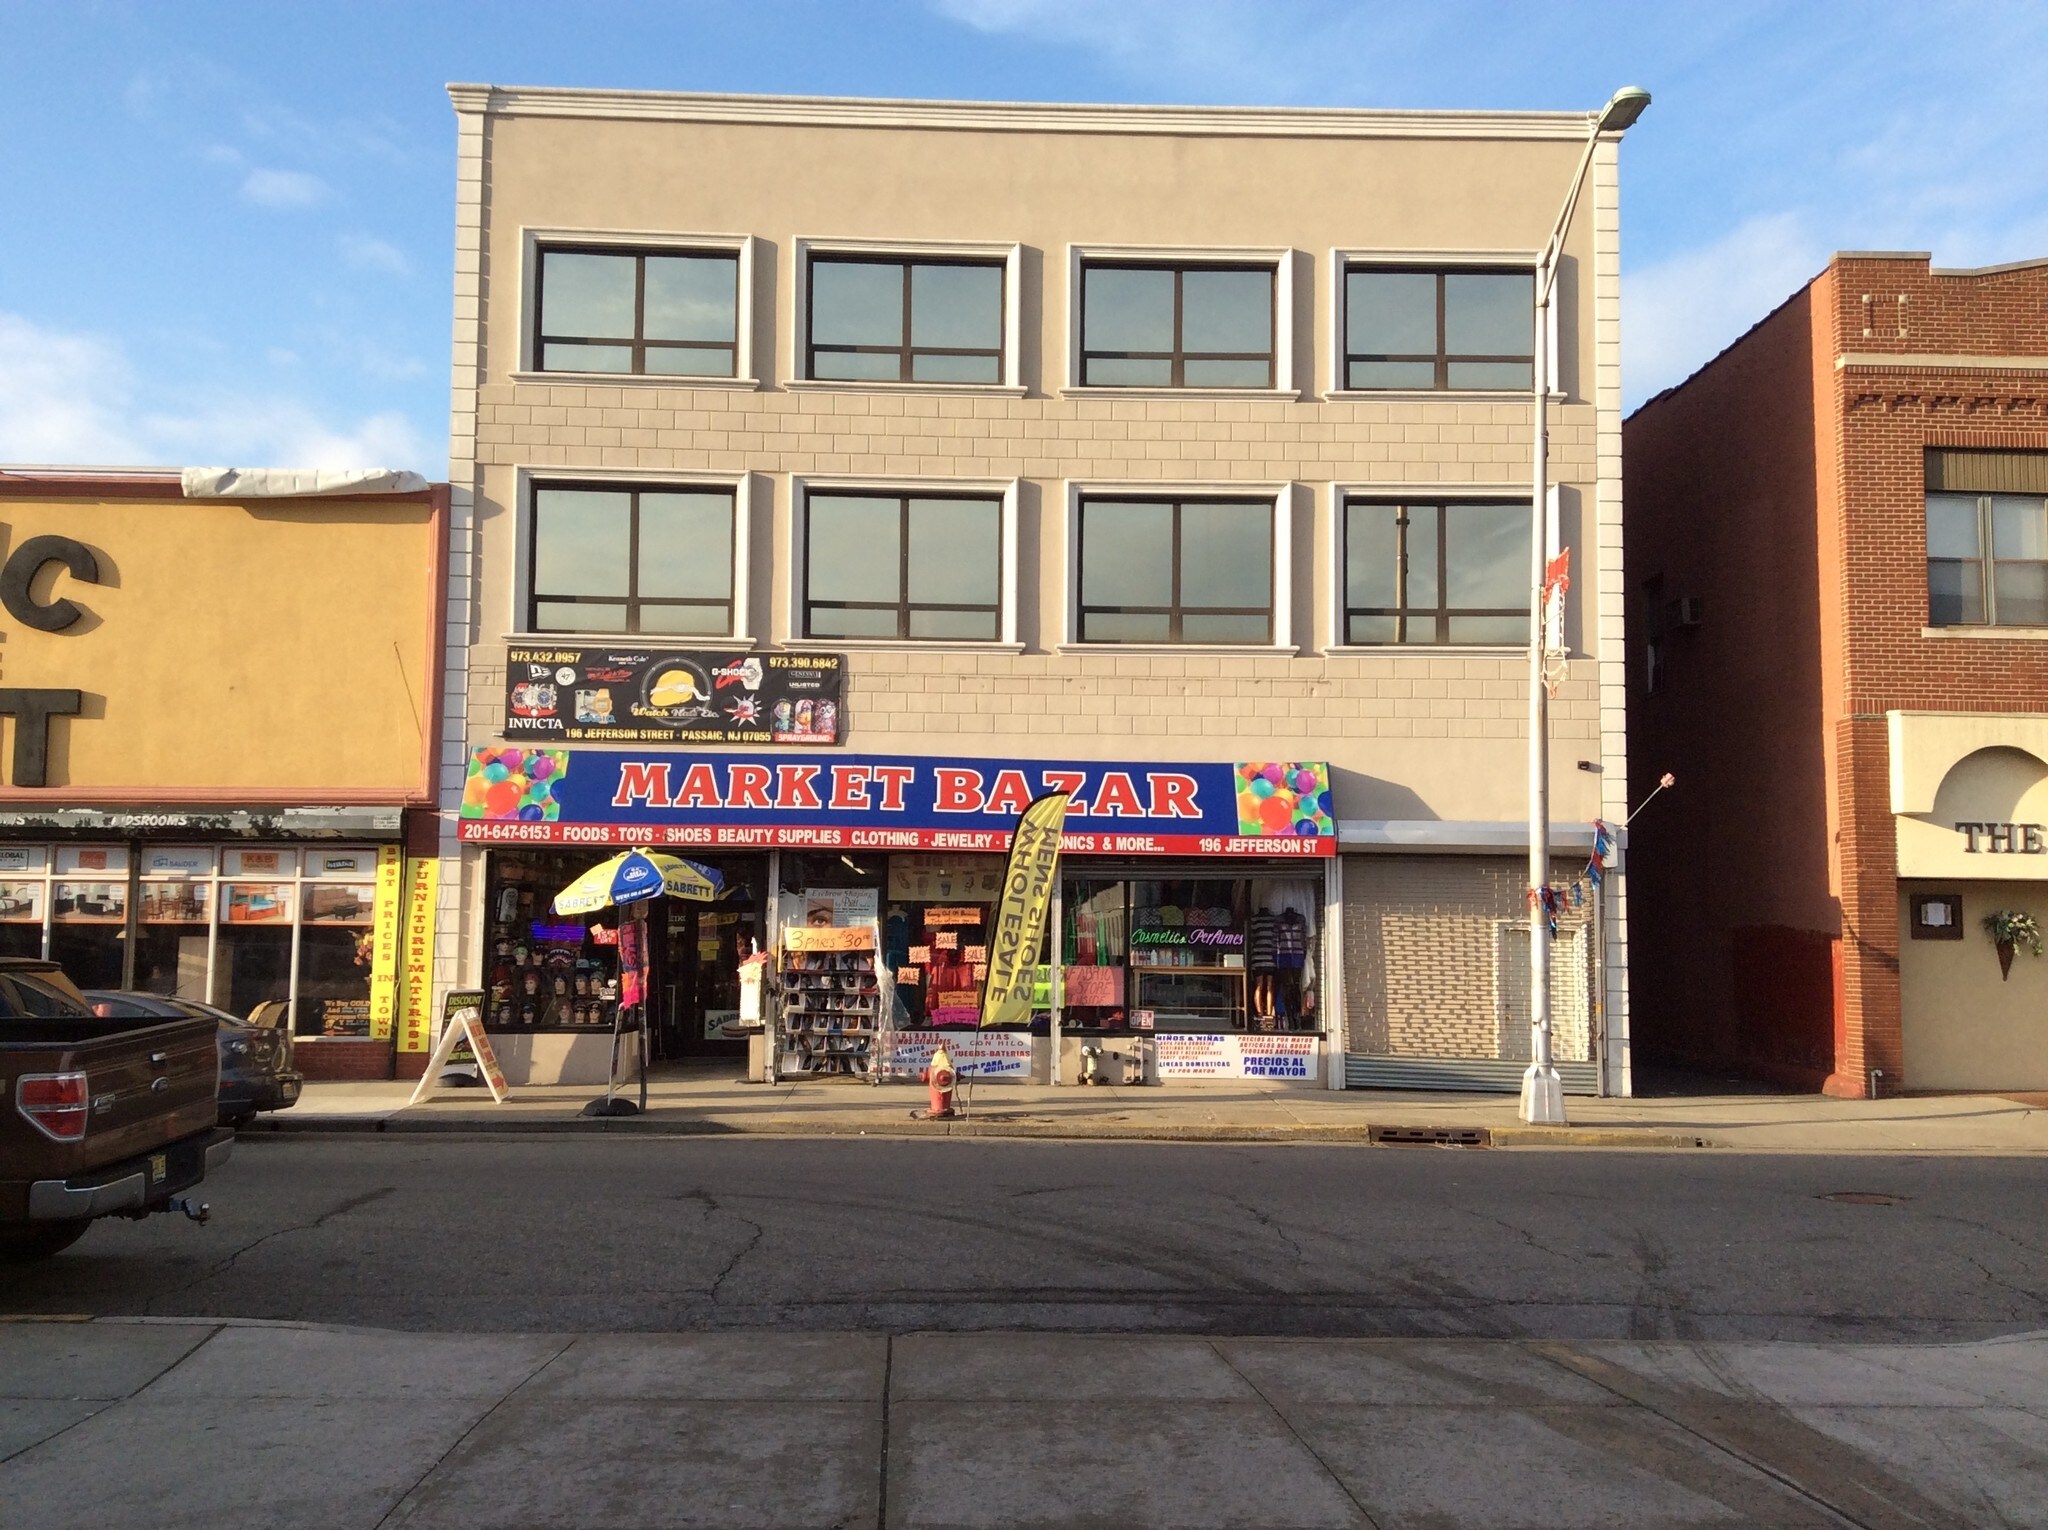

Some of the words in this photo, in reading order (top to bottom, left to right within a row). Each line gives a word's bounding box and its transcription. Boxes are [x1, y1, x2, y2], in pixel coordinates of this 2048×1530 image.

[511, 651, 581, 663] 973.432.0957
[769, 657, 838, 669] 973.390.6842
[508, 718, 563, 729] INVICTA
[566, 728, 582, 738] 196
[585, 728, 639, 739] JEFFERSON
[640, 729, 674, 739] STREET
[682, 730, 725, 741] PASSAIC,
[728, 731, 742, 740] NJ
[744, 732, 771, 741] 07055
[612, 763, 914, 812] MARKET
[933, 767, 1203, 819] BAZAR
[464, 824, 552, 840] 201-647-6153
[563, 826, 609, 842] FOODS
[618, 826, 653, 842] TOYS
[665, 827, 712, 843] SHOES
[717, 828, 774, 843] BEAUTY
[778, 828, 841, 844] SUPPLIES
[851, 829, 919, 847] CLOTHING
[930, 832, 993, 848] JEWELRY
[1102, 836, 1113, 850] &
[1199, 839, 1222, 852] 196
[1225, 838, 1301, 853] JEFFERSON
[1302, 839, 1317, 853] ST
[1955, 822, 2043, 854] THE
[666, 881, 711, 897] SABRETT
[382, 900, 394, 961] PRICES
[1188, 928, 1244, 946] Perfumes
[938, 935, 957, 945] SALE
[377, 974, 394, 982] IN
[1077, 981, 1112, 995] STORE
[376, 996, 390, 1036] TOWN
[1131, 1016, 1151, 1026] OPEN
[1243, 1057, 1289, 1066] PRECIOS
[1292, 1058, 1305, 1066] AL
[1244, 1066, 1266, 1075] POR
[1268, 1067, 1306, 1076] MAYOR
